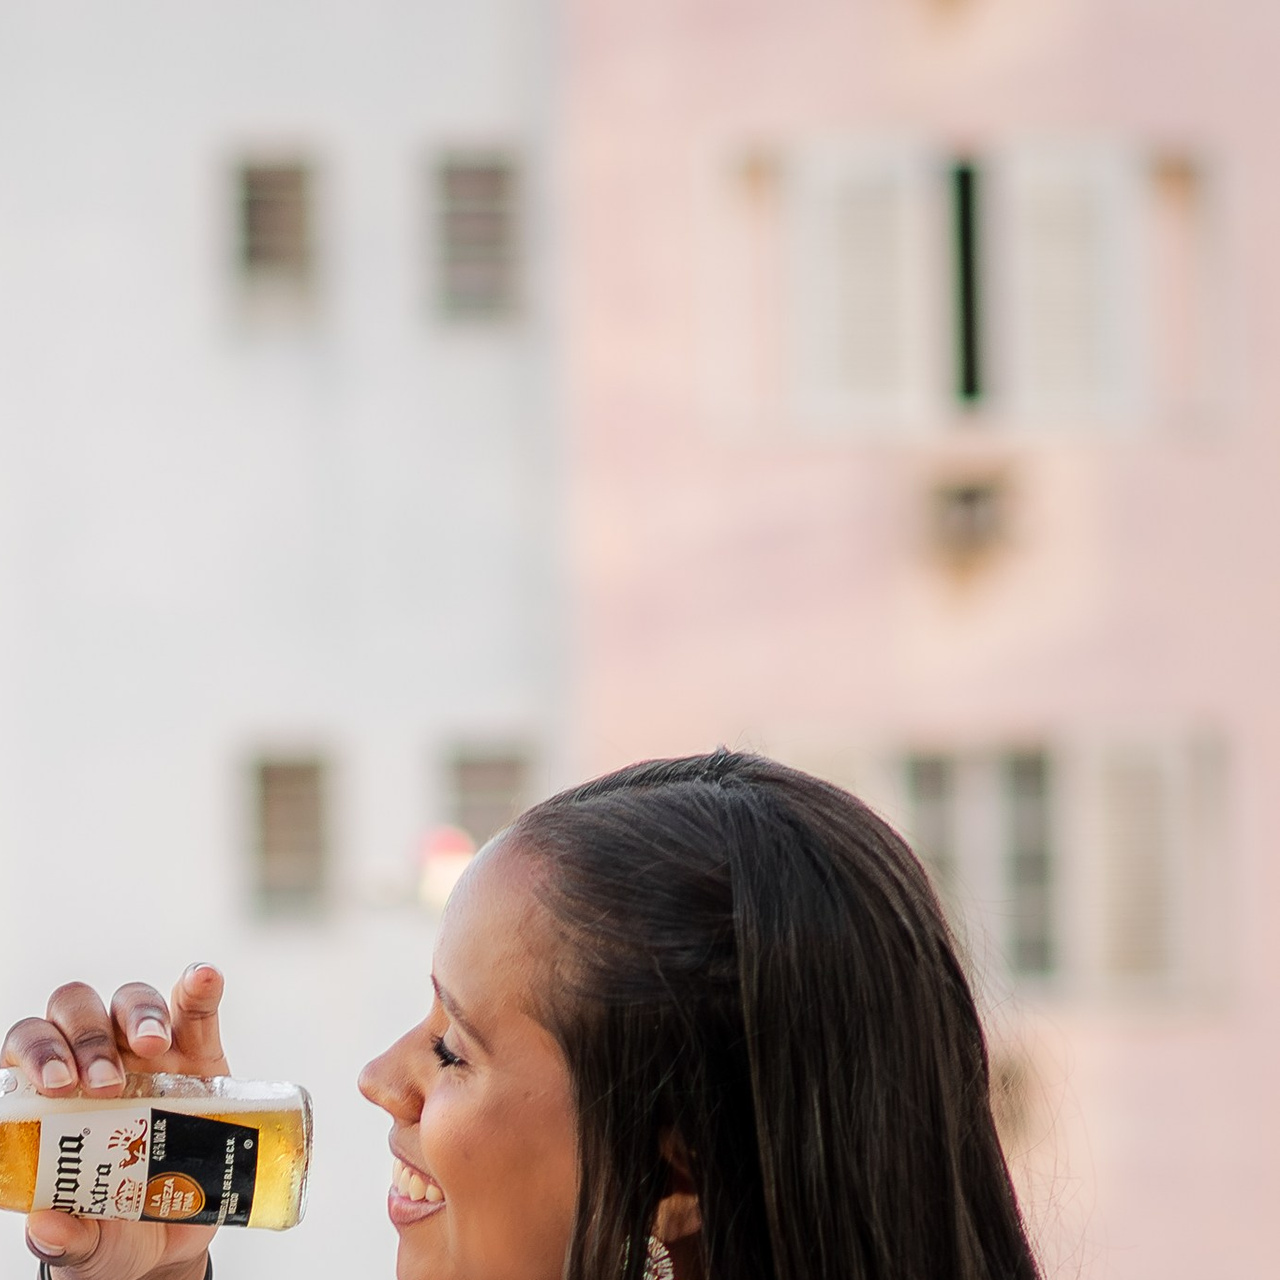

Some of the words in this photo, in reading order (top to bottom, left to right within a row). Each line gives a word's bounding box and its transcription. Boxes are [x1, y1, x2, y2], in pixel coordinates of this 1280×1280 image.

[225, 1153, 234, 1165] DE
[79, 1163, 112, 1215] Extra
[160, 1178, 175, 1218] CERVEZA
[150, 1194, 162, 1207] LA
[182, 1191, 195, 1212] FINA
